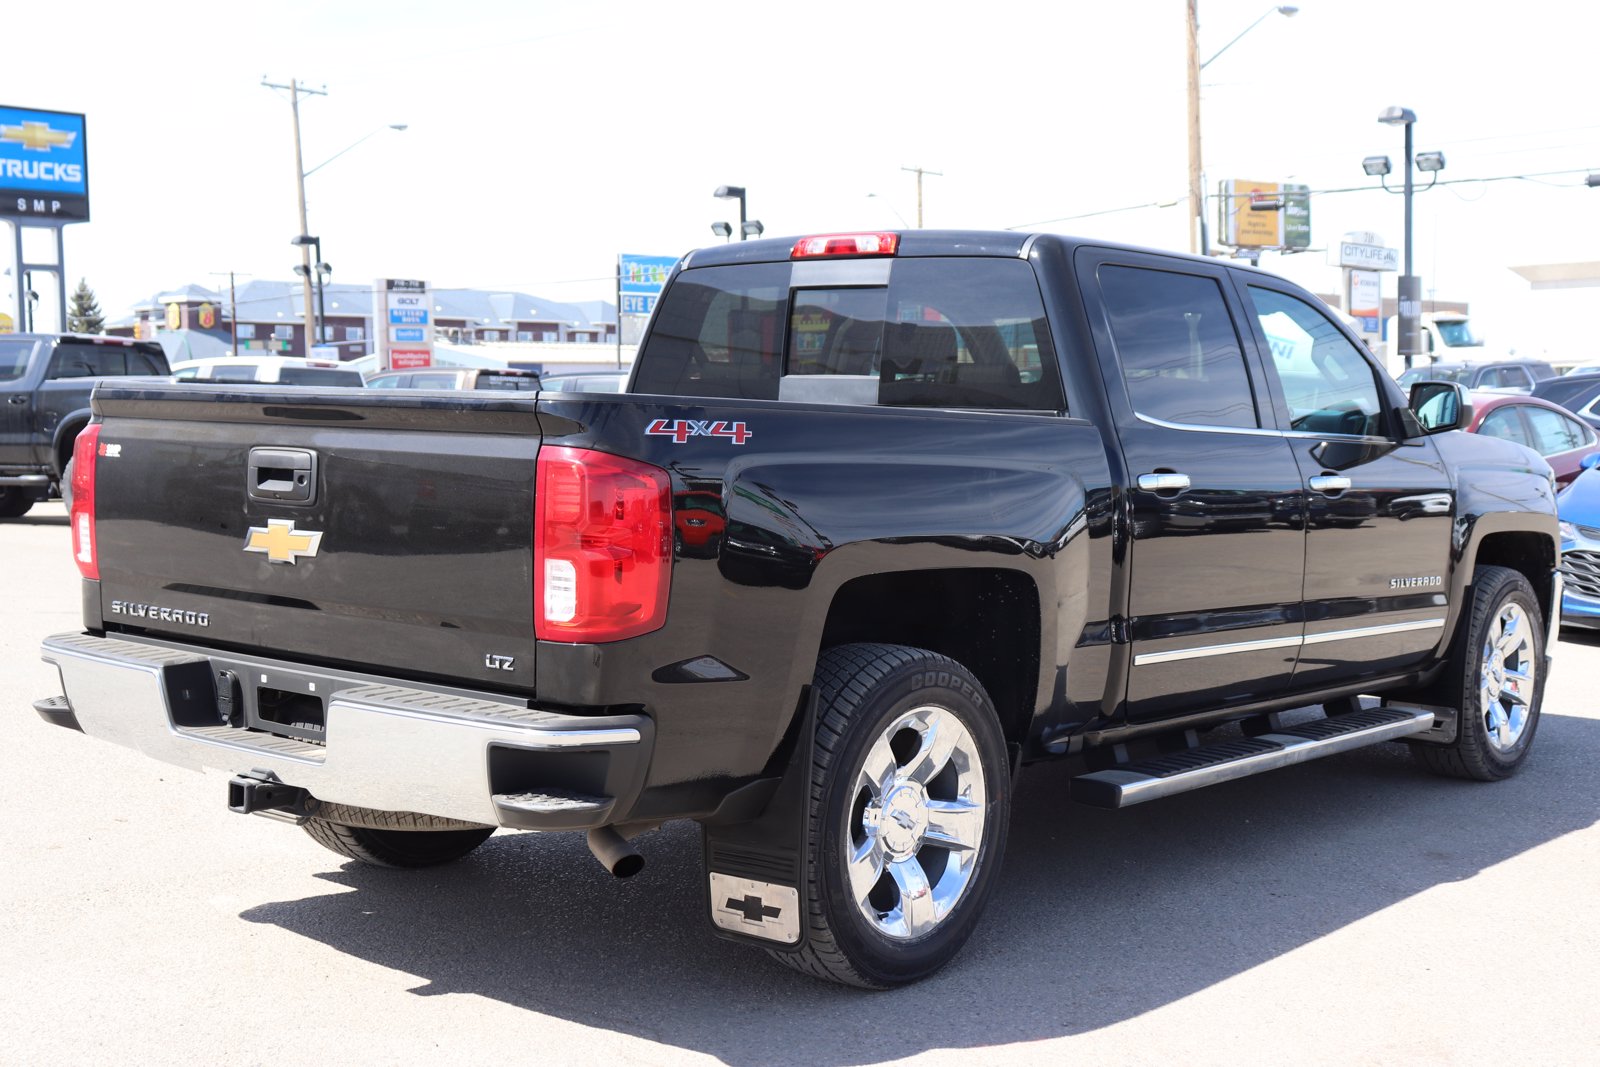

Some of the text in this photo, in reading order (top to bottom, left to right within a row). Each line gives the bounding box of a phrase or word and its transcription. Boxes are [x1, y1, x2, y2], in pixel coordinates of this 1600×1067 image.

[1344, 245, 1383, 261] CITYLIFE
[624, 296, 644, 311] EYE
[1389, 575, 1443, 590] SILVERADO
[111, 600, 211, 627] SILVERADO
[486, 654, 514, 671] LTZ
[911, 670, 983, 709] COOPER
